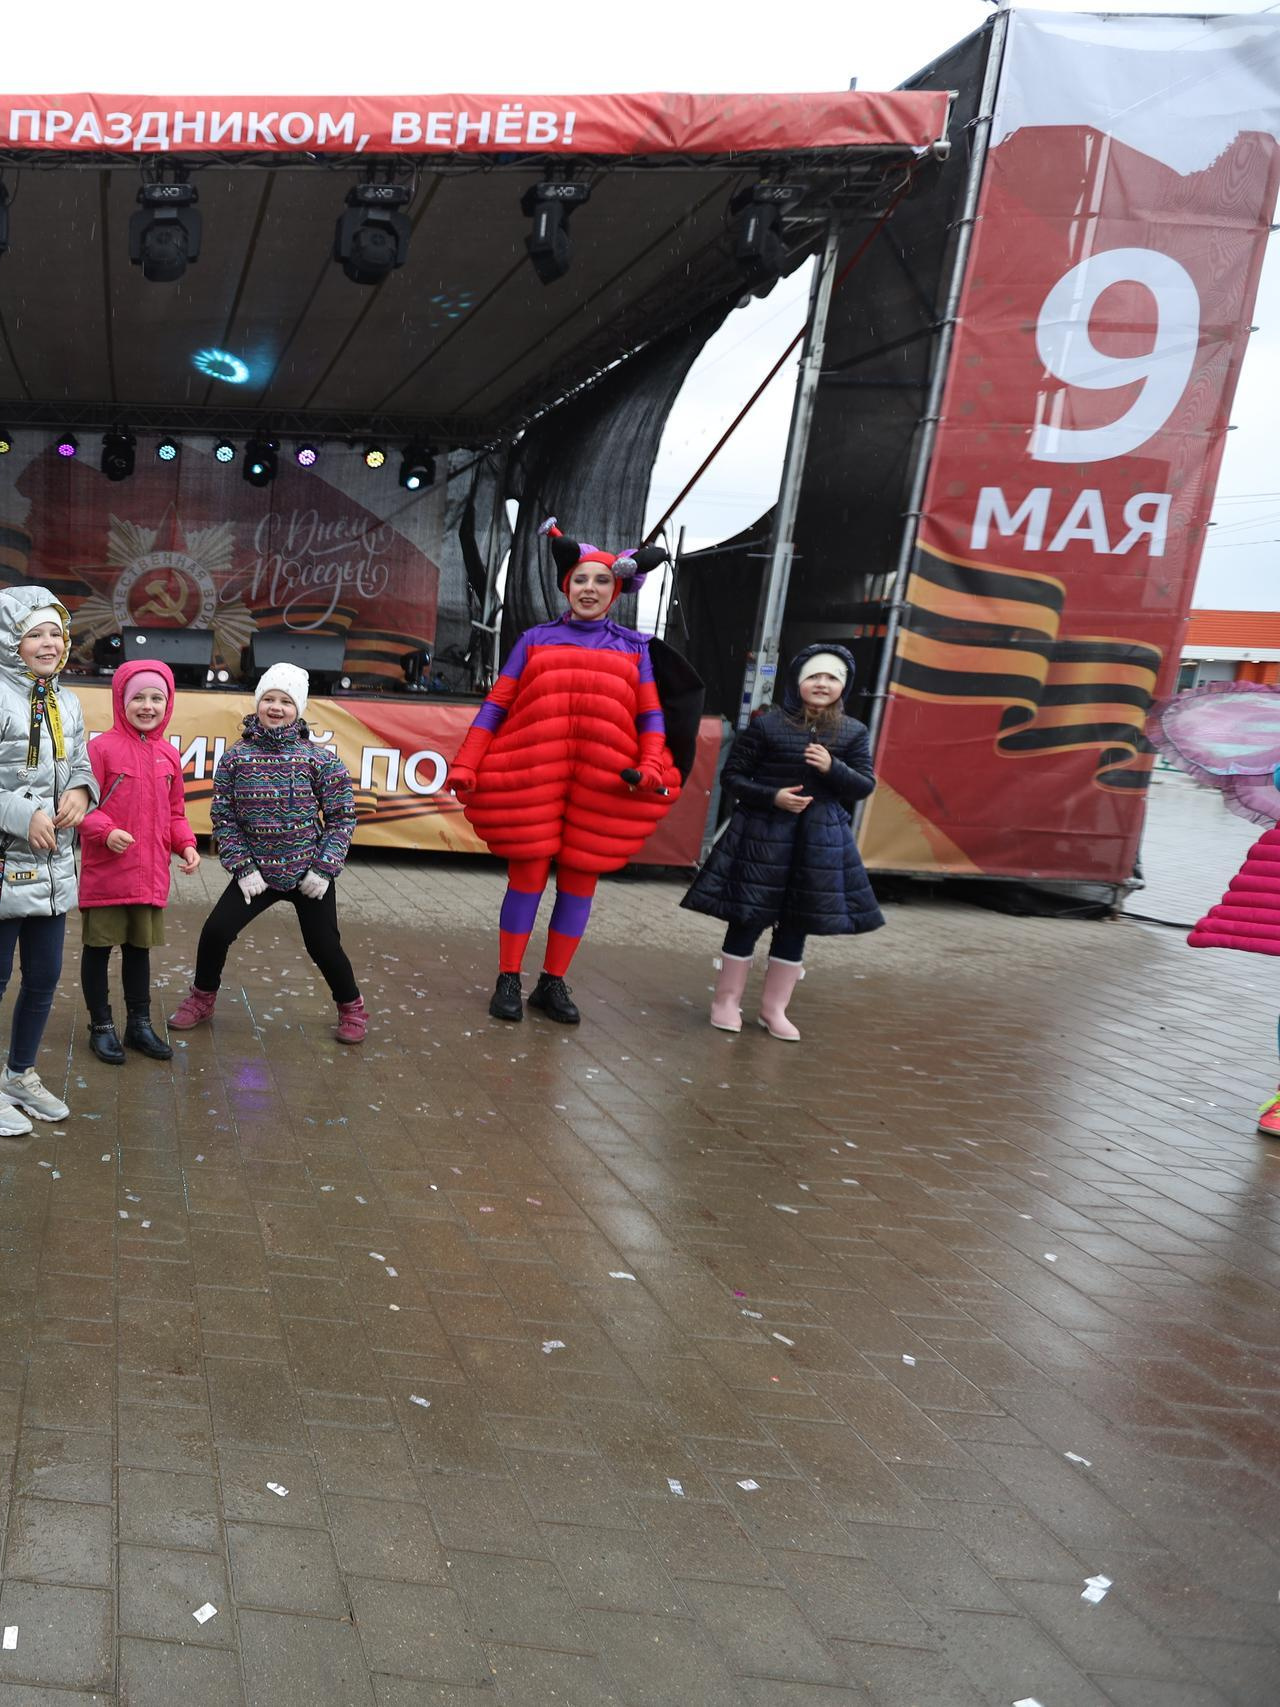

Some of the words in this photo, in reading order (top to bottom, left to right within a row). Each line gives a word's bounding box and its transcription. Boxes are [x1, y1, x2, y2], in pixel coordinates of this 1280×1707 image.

[8, 108, 370, 152] ПРАЗДНИКОМ,
[390, 103, 576, 145] ВЕНЁВ!
[1032, 247, 1201, 463] 9
[970, 486, 1173, 557] МАЯ
[360, 746, 453, 796] ПО
